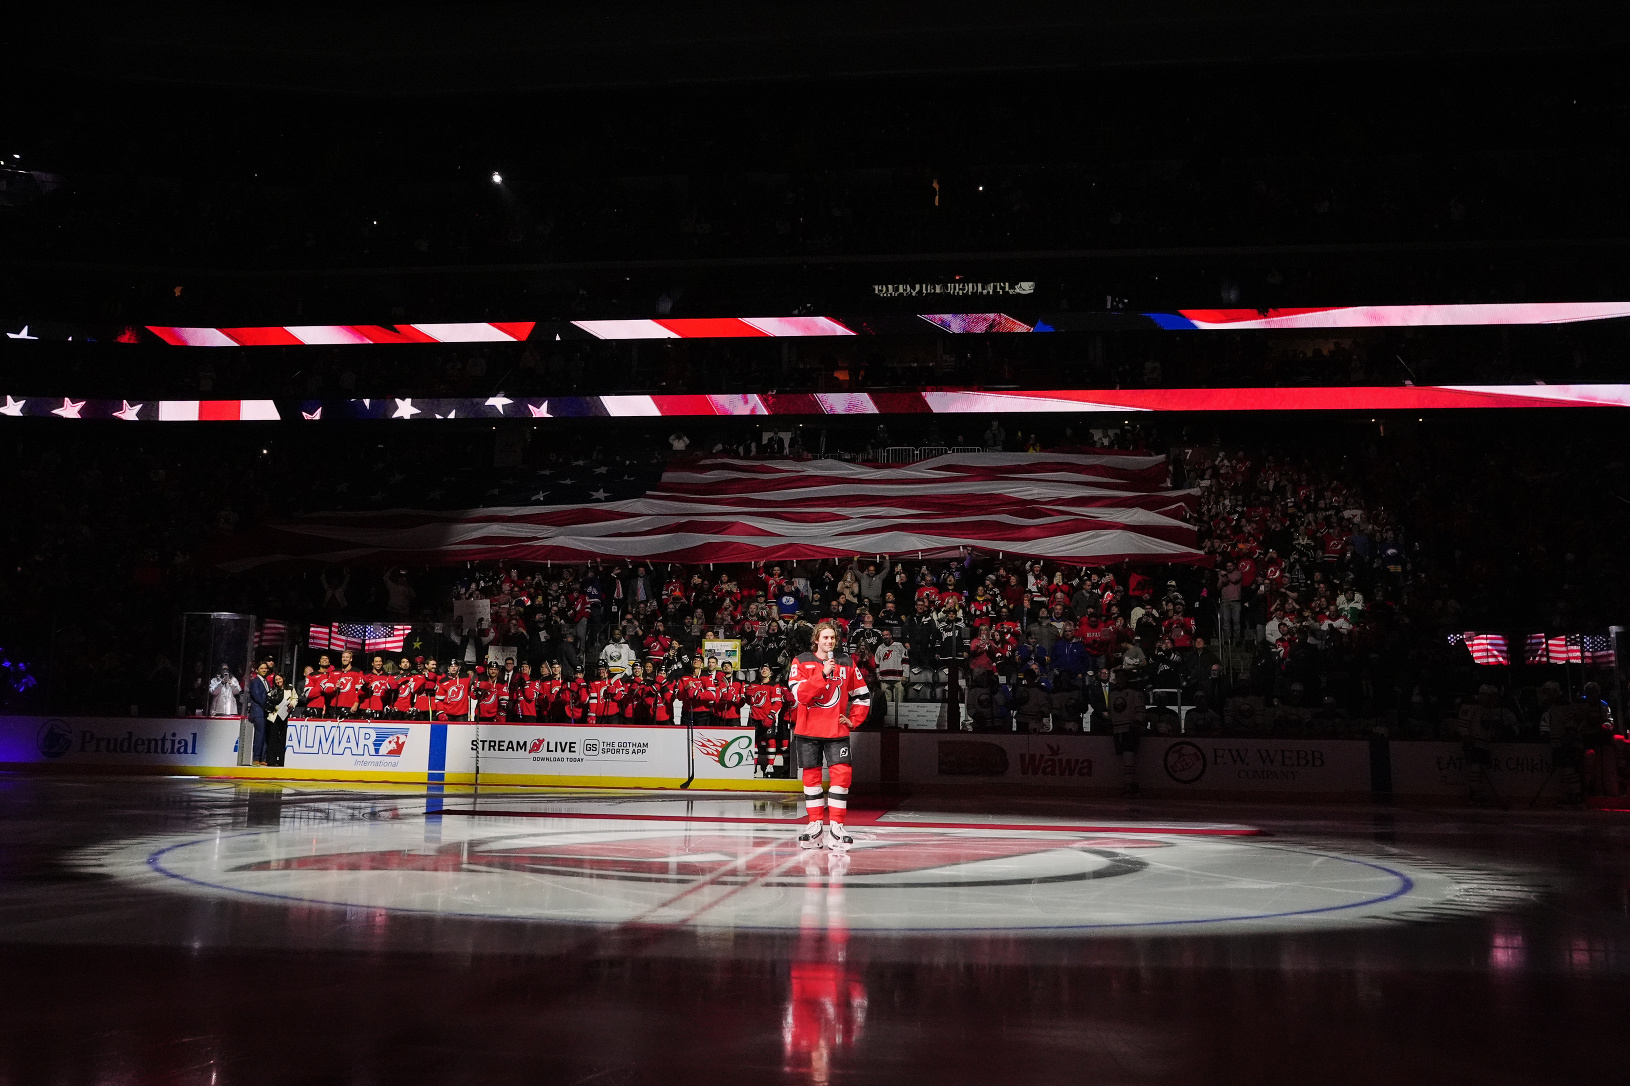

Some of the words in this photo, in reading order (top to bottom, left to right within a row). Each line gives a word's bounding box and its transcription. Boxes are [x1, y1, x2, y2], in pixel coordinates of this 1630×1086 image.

[839, 667, 846, 679] A
[79, 730, 197, 755] Prudential
[470, 740, 528, 752] STREAM
[546, 741, 577, 753] LIVE
[585, 743, 597, 752] GS
[617, 741, 649, 749] GOTHAM
[601, 747, 629, 755] SPORTS
[354, 759, 399, 768] International
[1213, 748, 1249, 766] F.W.
[1257, 749, 1325, 768] WEBB
[1436, 755, 1466, 771] EAT
[1019, 753, 1093, 777] Wawa
[1237, 769, 1298, 780] COMPANY
